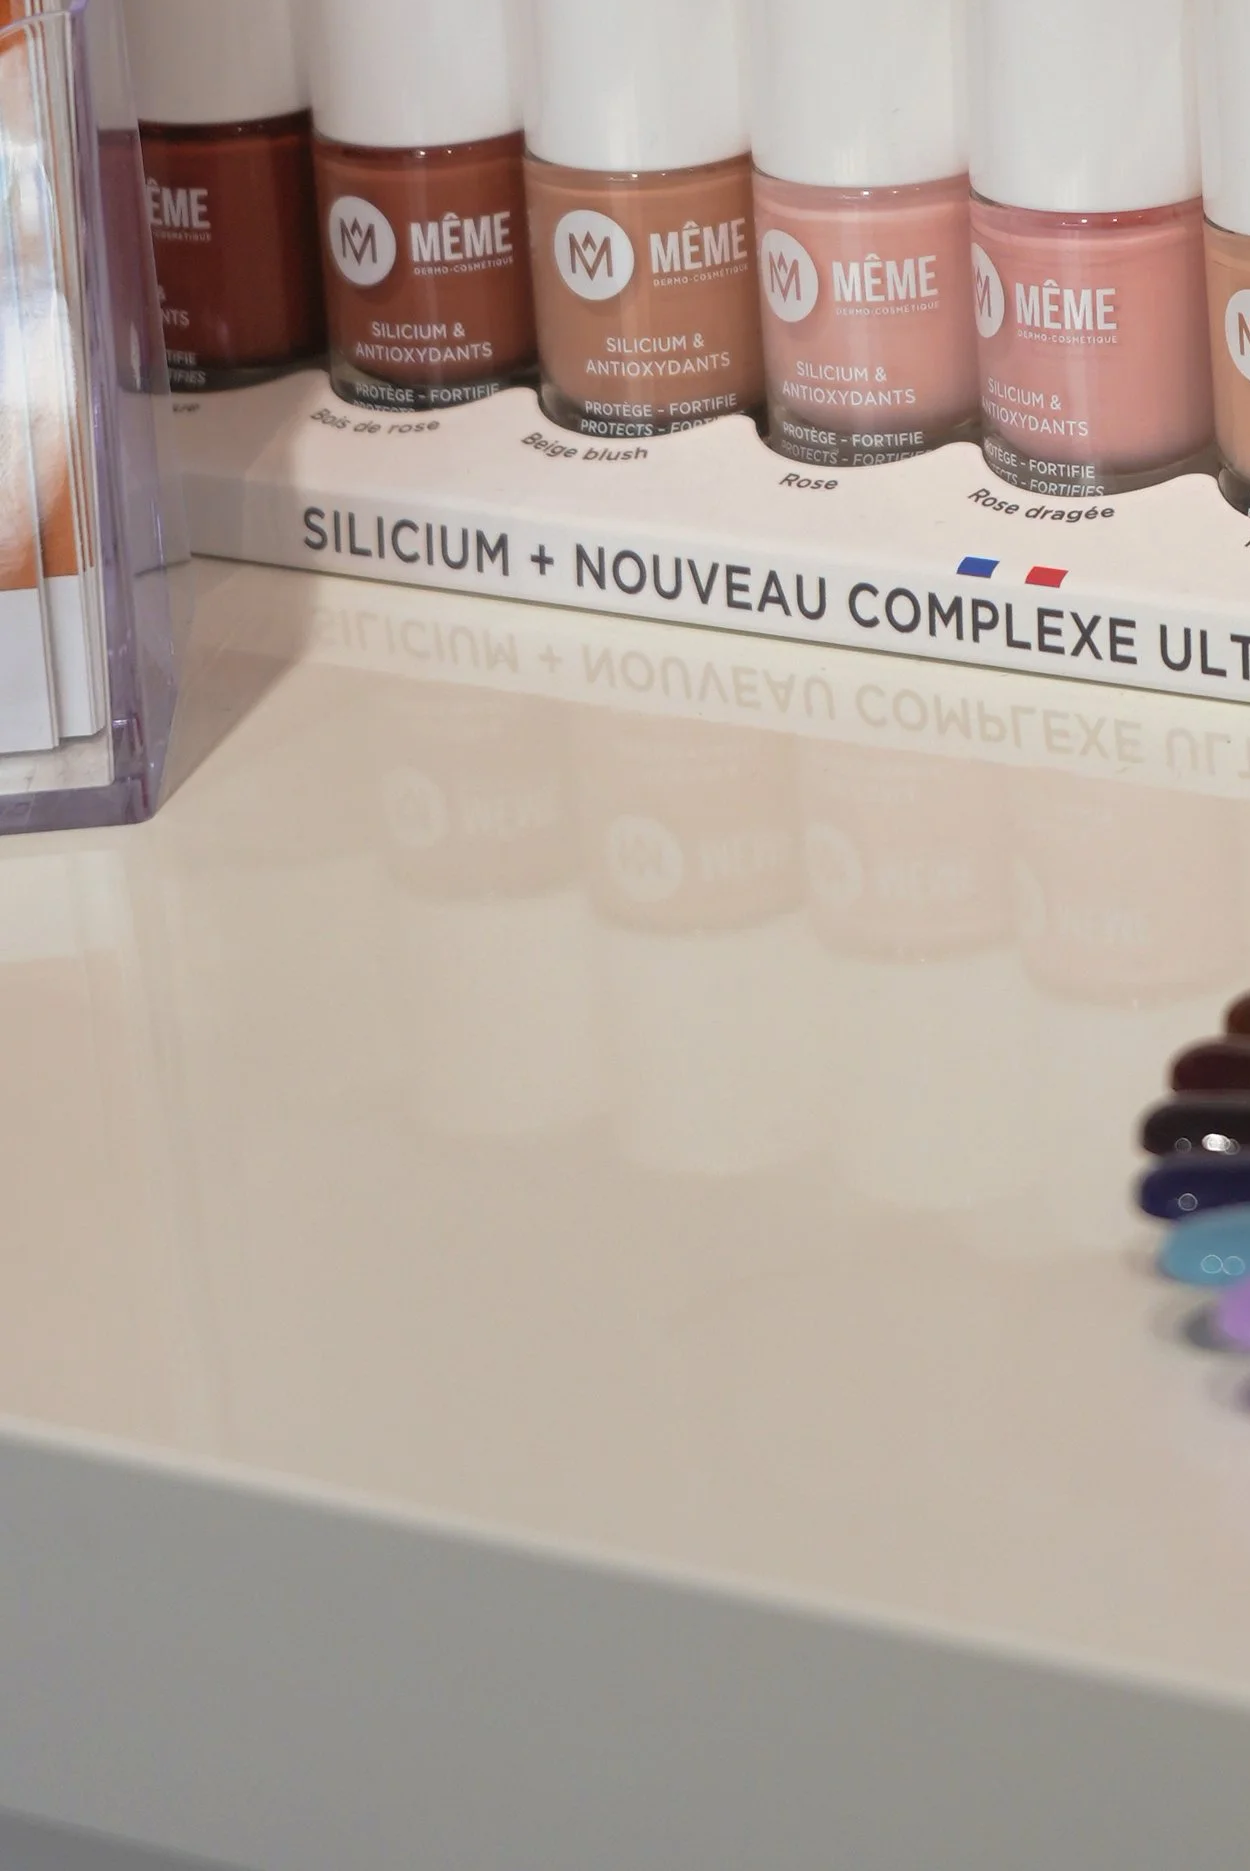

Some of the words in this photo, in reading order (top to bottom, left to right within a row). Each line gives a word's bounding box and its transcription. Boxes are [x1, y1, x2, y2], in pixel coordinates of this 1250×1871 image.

[146, 176, 211, 230] ÊME
[410, 211, 513, 264] MÊME
[650, 218, 748, 275] MÊME
[832, 252, 939, 304] MÊME
[1015, 278, 1118, 331] MÊME
[371, 321, 448, 341] SILICIUM
[452, 322, 467, 339] &
[606, 334, 687, 354] SILICIUM
[693, 333, 706, 349] &
[355, 341, 494, 364] ANTIOXYDANTS
[585, 351, 731, 378] ANTIOXYDANTS
[796, 360, 868, 383] SILICIUM
[875, 366, 888, 383] &
[585, 400, 653, 418] PROTÈGE
[669, 392, 737, 416] FORTIFIE
[782, 380, 917, 407] ANTIOXYDANTS
[988, 377, 1044, 409] SILICIUM
[1050, 394, 1062, 411] &
[311, 408, 348, 431] Bois
[353, 420, 381, 434] de
[387, 420, 440, 435] rose
[580, 418, 654, 437] PROTECTS
[783, 421, 837, 446] PROTÈGE
[852, 431, 924, 447] FORTIFIE
[520, 431, 579, 460] Beige
[582, 446, 649, 461] blush
[778, 472, 840, 491] Rose
[1029, 459, 1096, 480] FORTIFIE
[967, 488, 1020, 516] Rose
[1025, 503, 1116, 524] dragée
[303, 506, 510, 577] SILICIUM
[530, 543, 554, 576] +
[575, 543, 828, 622] NOUVEAU
[848, 582, 1139, 666] COMPLEXE
